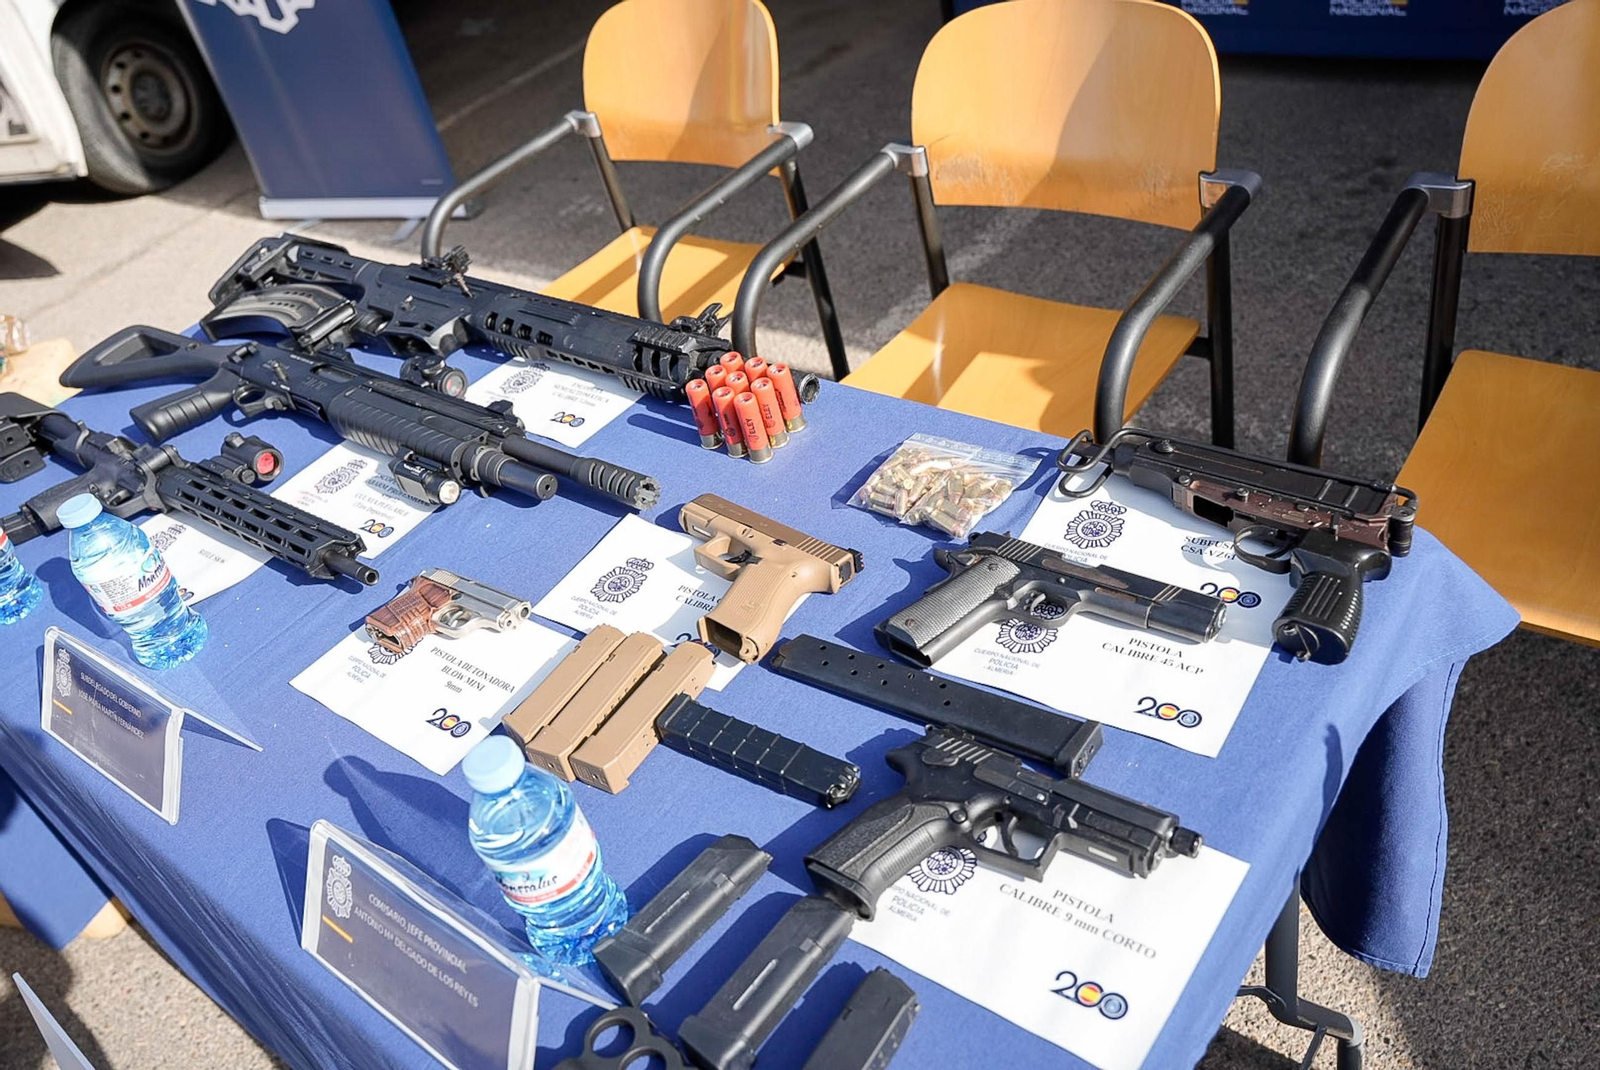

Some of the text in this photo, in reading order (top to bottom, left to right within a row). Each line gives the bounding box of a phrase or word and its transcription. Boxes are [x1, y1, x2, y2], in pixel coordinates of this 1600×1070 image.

[1329, 6, 1407, 16] NACIONAL
[359, 519, 394, 538] 200
[1069, 549, 1098, 559] NACIONAL
[974, 648, 1041, 669] CUERPO NACIONAL DE
[1102, 642, 1204, 675] CALIBRE 45 ACP
[1128, 637, 1183, 659] PISTOLA
[430, 646, 516, 694] PISTOLA DETONADORA
[441, 665, 486, 692] BLOW MINI
[425, 707, 472, 738] 200
[1133, 696, 1203, 729] 200
[999, 882, 1157, 960] CALIBRE 9 mm CORTO
[1052, 889, 1115, 924] PISTOLA
[354, 906, 384, 935] ANTONIO
[394, 936, 427, 969] DELGADO
[427, 962, 438, 977] DE
[438, 970, 454, 989] LOS
[454, 981, 479, 1008] REYES
[406, 922, 424, 941] JEFE
[423, 934, 468, 974] PROVINCIAL
[1049, 970, 1129, 1020] 200
